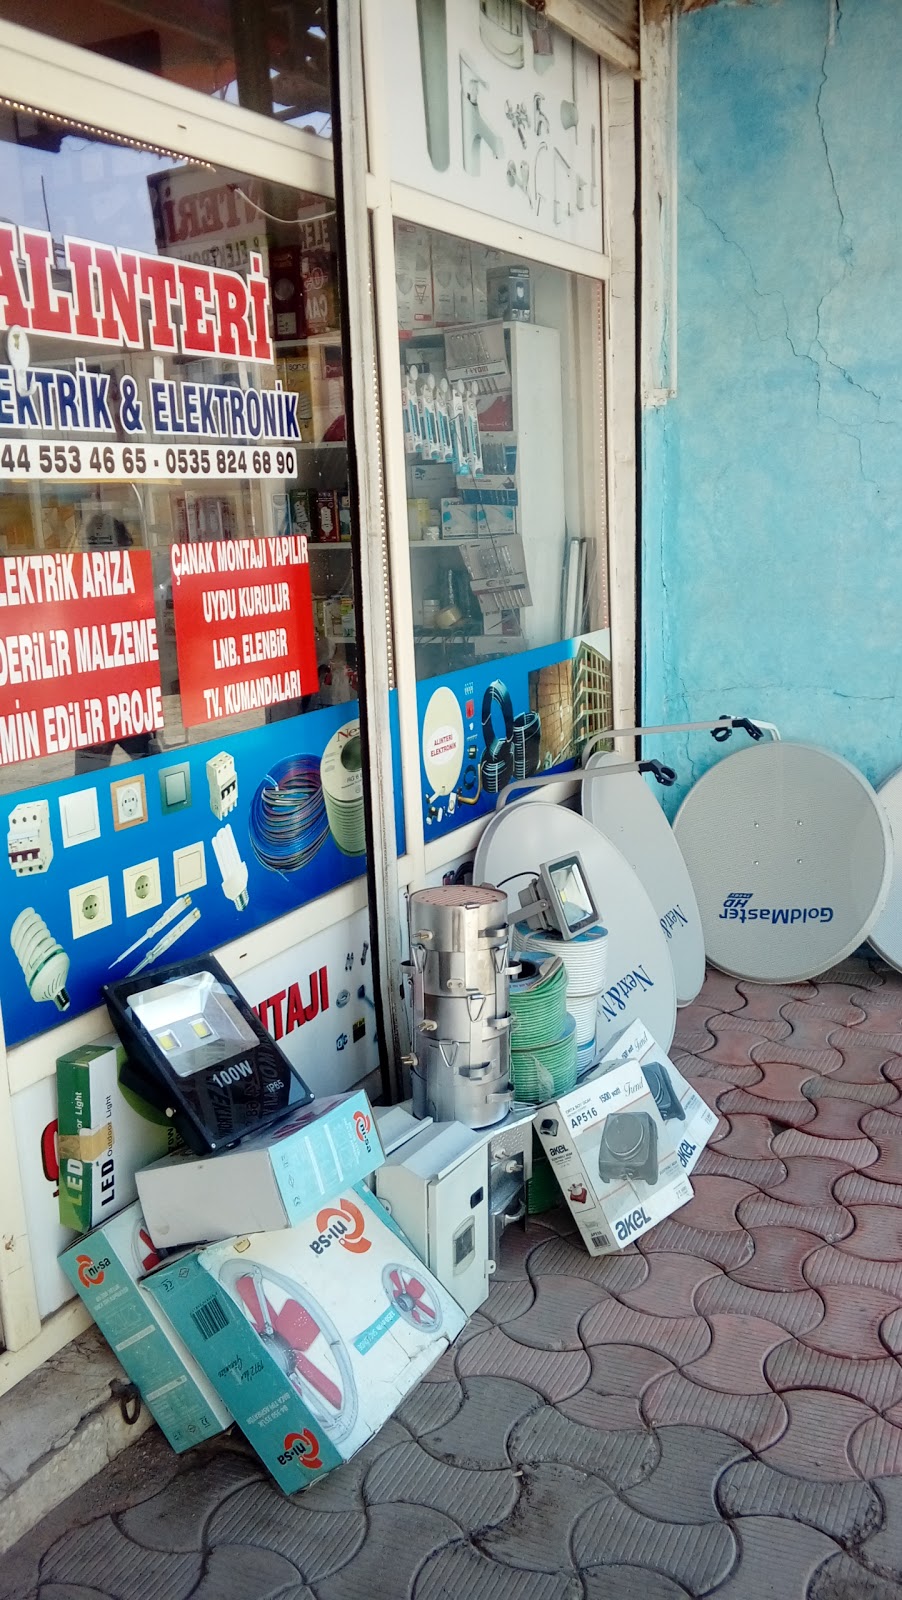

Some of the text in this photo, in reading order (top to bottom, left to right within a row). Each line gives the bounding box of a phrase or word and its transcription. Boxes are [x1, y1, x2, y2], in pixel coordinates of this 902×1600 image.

[121, 376, 145, 433] &
[151, 381, 300, 440] ELEKTRONİK
[39, 445, 81, 474] 553
[90, 446, 115, 474] 46
[122, 447, 147, 474] 65
[166, 448, 210, 474] 0535
[217, 450, 248, 474] 824
[252, 450, 271, 474] 68
[276, 451, 295, 474] 90
[171, 535, 308, 585] ÇANAK MONTAJI YAPILIR
[0, 551, 135, 607] EKTRİK ARIZA
[202, 582, 290, 623] UYDU KURULUR
[74, 618, 159, 673] MALZEME
[212, 636, 240, 670] LNB.
[109, 687, 164, 738] PROJE
[204, 670, 301, 719] TV. KUMANDALARI
[719, 906, 833, 924] GoldMaster
[723, 899, 749, 908] HD
[212, 1060, 254, 1088] 100W
[266, 1079, 285, 1093] IP65
[74, 1091, 84, 1116] Light
[599, 1092, 612, 1103] 1500
[569, 1107, 599, 1128] AP516
[101, 1094, 115, 1206] LED Outdoor Light
[66, 1158, 84, 1207] LED
